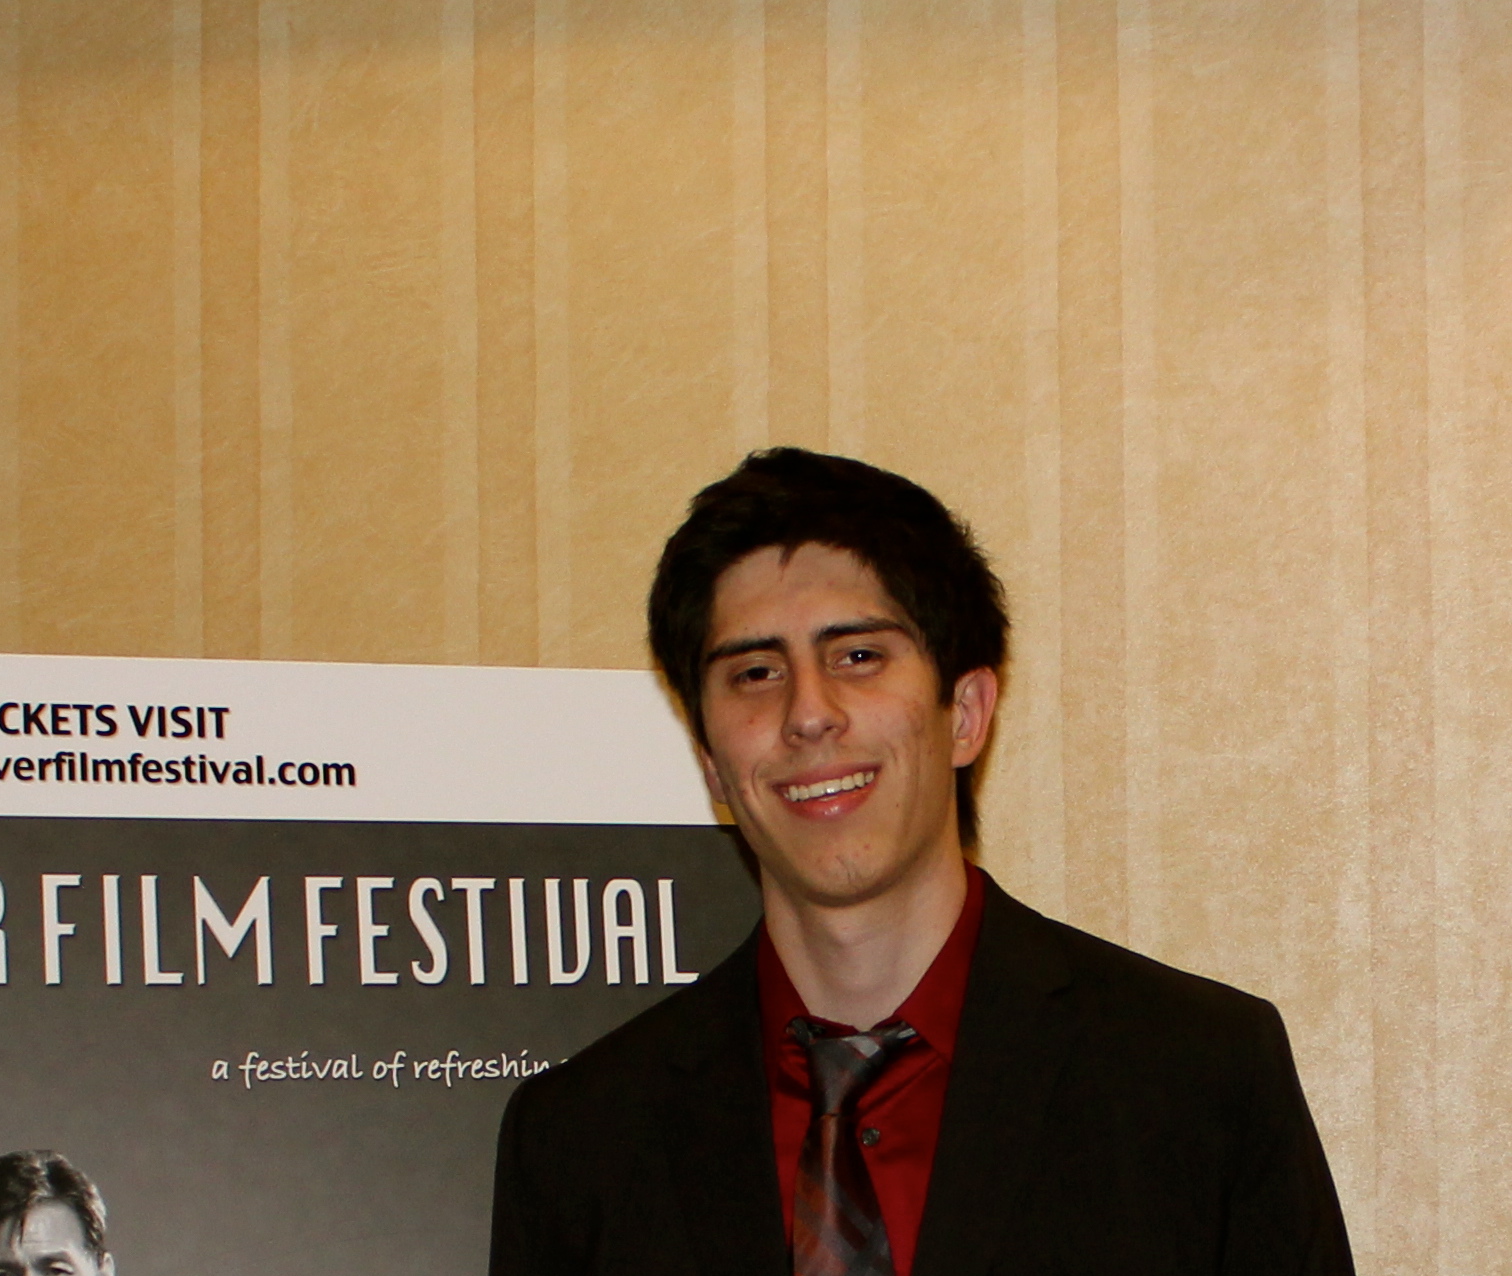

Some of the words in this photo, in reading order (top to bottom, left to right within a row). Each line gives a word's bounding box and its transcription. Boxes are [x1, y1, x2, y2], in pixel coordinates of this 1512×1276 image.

[127, 705, 230, 739] VISIT
[41, 874, 273, 986] FILM
[304, 876, 700, 986] FESTIVAL
[211, 1060, 229, 1080] a
[238, 1050, 364, 1089] festival
[372, 1050, 407, 1088] of
